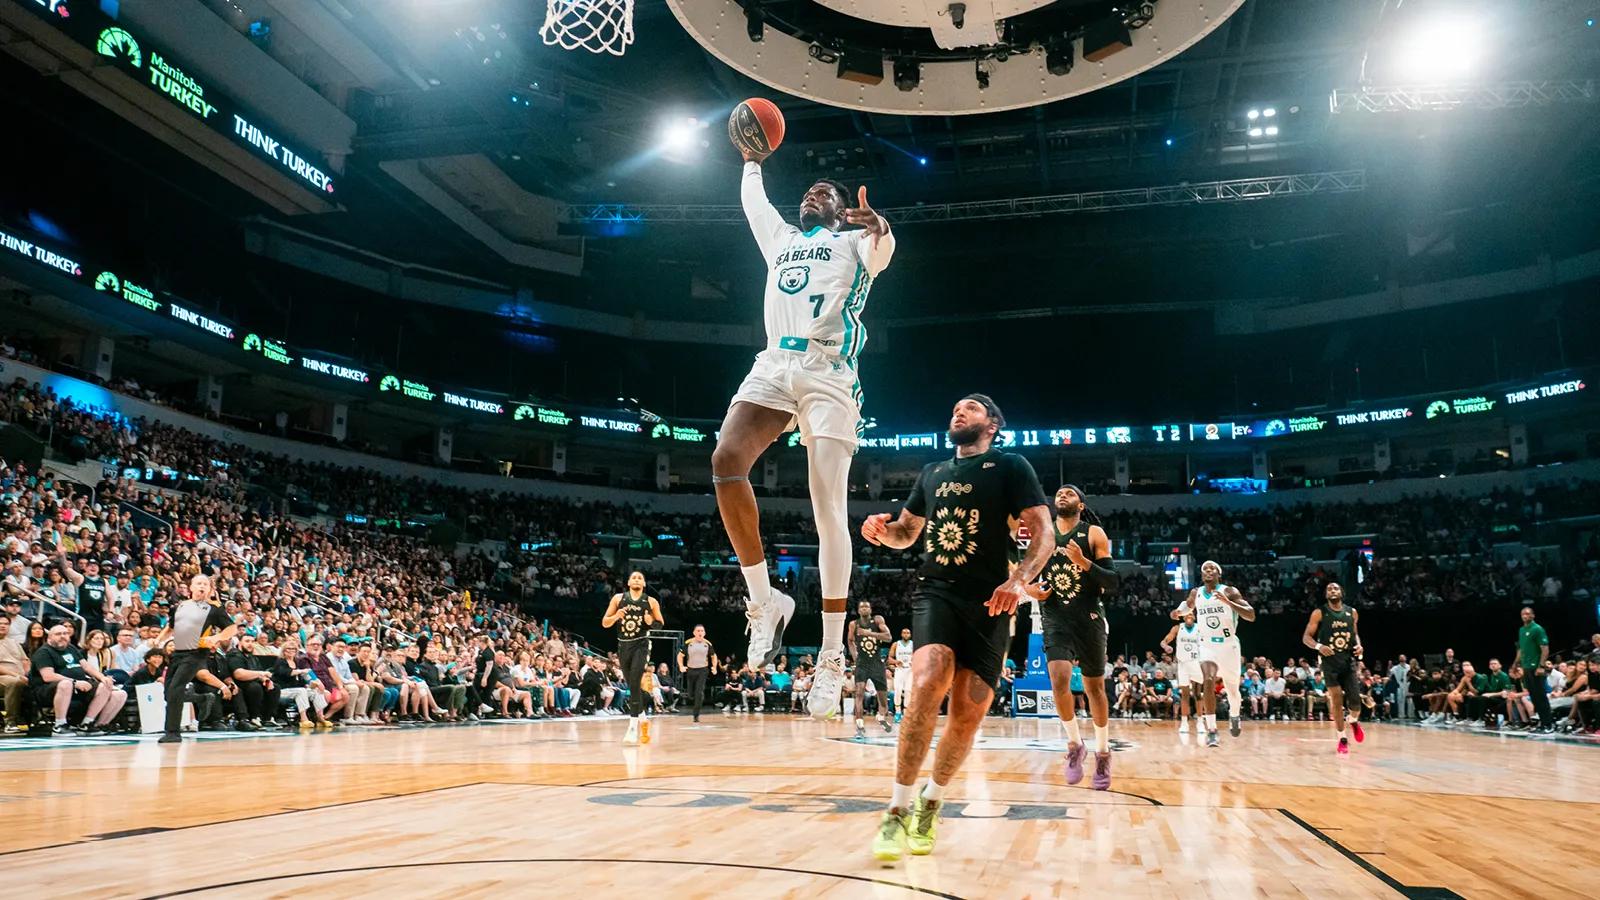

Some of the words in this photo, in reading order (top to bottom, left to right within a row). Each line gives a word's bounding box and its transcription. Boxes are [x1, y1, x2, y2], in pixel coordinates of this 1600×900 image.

[150, 52, 203, 96] Manitoba
[150, 66, 213, 119] TURKEY
[233, 113, 280, 160] THINK
[281, 146, 331, 192] TURKEY
[35, 246, 79, 275] TURKEY
[792, 247, 832, 262] BEARS
[124, 279, 154, 299] Manitoba
[123, 288, 159, 312] TURKEY
[809, 294, 825, 319] 7
[170, 303, 199, 326] THINK
[200, 316, 232, 340] TURKEY
[263, 347, 292, 366] TURKEY
[302, 358, 330, 375] THINK
[331, 365, 367, 383] TURKEY
[402, 386, 434, 401] TURKEY
[403, 380, 429, 392] Manitoba
[1505, 388, 1539, 405] THINK
[1540, 380, 1582, 399] TURKEY
[443, 393, 468, 407] THINK
[469, 398, 502, 414] TURKEY
[1453, 397, 1487, 408] Manitoba
[1454, 402, 1493, 415] TURKEY
[538, 414, 570, 426] TURKEY
[580, 416, 609, 428] THINK
[609, 420, 640, 433] TURKEY
[1289, 417, 1318, 425] Manitoba
[1336, 413, 1369, 426] THINK
[1369, 408, 1409, 422] TURKEY
[1289, 422, 1325, 432] TURKEY
[673, 432, 704, 442] TURKEY
[1022, 430, 1039, 446] 11
[1085, 428, 1096, 443] 6
[1156, 430, 1164, 441] 1
[970, 509, 980, 524] 9
[1223, 628, 1231, 638] 6
